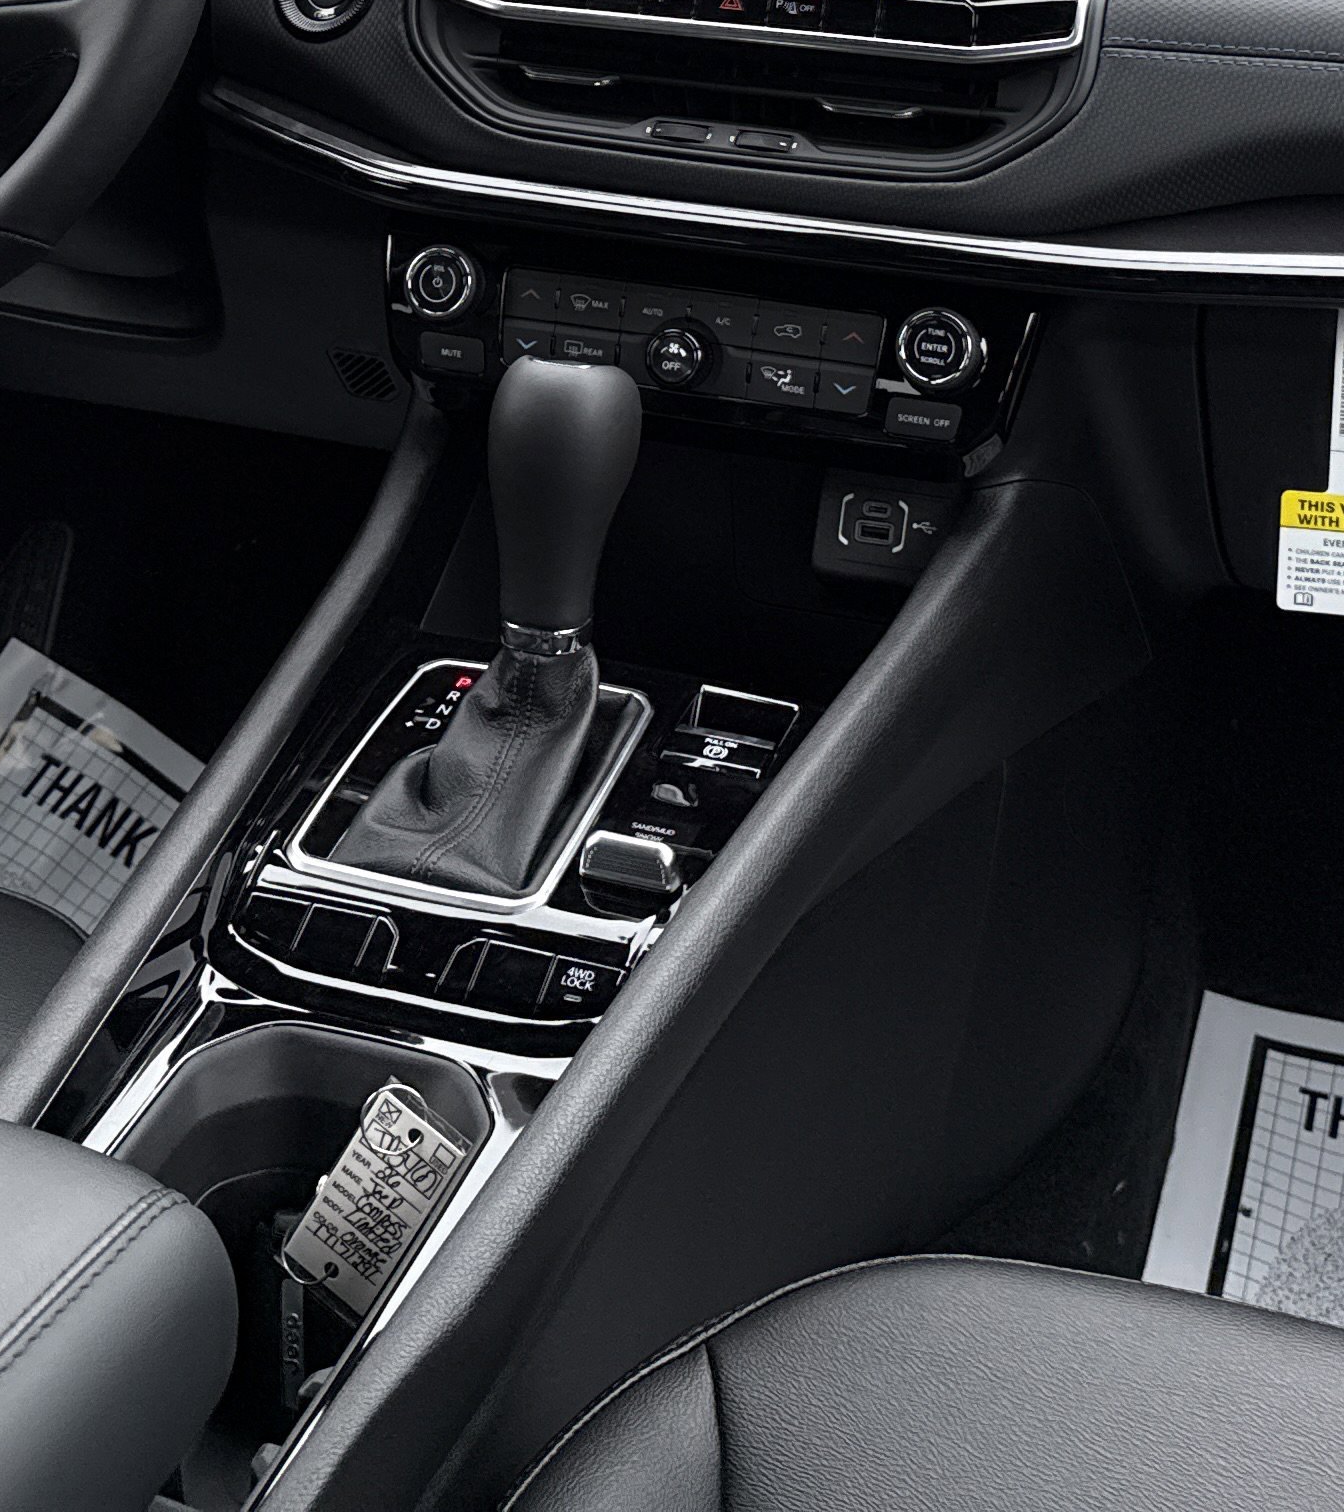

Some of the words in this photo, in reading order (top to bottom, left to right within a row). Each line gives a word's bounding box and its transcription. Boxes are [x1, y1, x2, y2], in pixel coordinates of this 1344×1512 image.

[799, 4, 814, 12] OFF
[591, 299, 609, 310] MAX
[642, 307, 664, 317] AUTO
[715, 317, 731, 326] A/C
[928, 328, 946, 337] TUNE
[583, 347, 603, 357] REAR
[921, 342, 948, 353] ENTER
[441, 348, 462, 359] MUTE
[661, 361, 681, 371] OFF
[920, 356, 945, 366] SCROLL
[781, 383, 805, 395] MODE
[897, 413, 930, 425] SCREEN
[933, 418, 951, 428] OFF
[1298, 499, 1336, 513] THIS
[1297, 513, 1340, 528] WITH
[1296, 548, 1330, 557] CHILDREN
[1310, 558, 1330, 566] BACK
[1295, 566, 1320, 575] NEVER
[1294, 575, 1326, 584] ALWAYS
[456, 677, 472, 688] P
[446, 691, 461, 701] R
[436, 704, 453, 715] N
[425, 718, 441, 729] D
[704, 737, 723, 747] PULL
[724, 741, 739, 749] ON
[21, 752, 161, 869] THANK
[631, 821, 676, 836] SAND/MUD
[567, 967, 595, 981] 4WD
[560, 975, 595, 991] LOCK
[374, 1113, 393, 1129] NEW
[351, 1150, 372, 1170] YEAR
[429, 1156, 449, 1176] USED
[341, 1165, 363, 1186] MAKE
[332, 1180, 358, 1205] MODEL
[322, 1196, 344, 1214] BODY
[313, 1211, 339, 1235] COLOR
